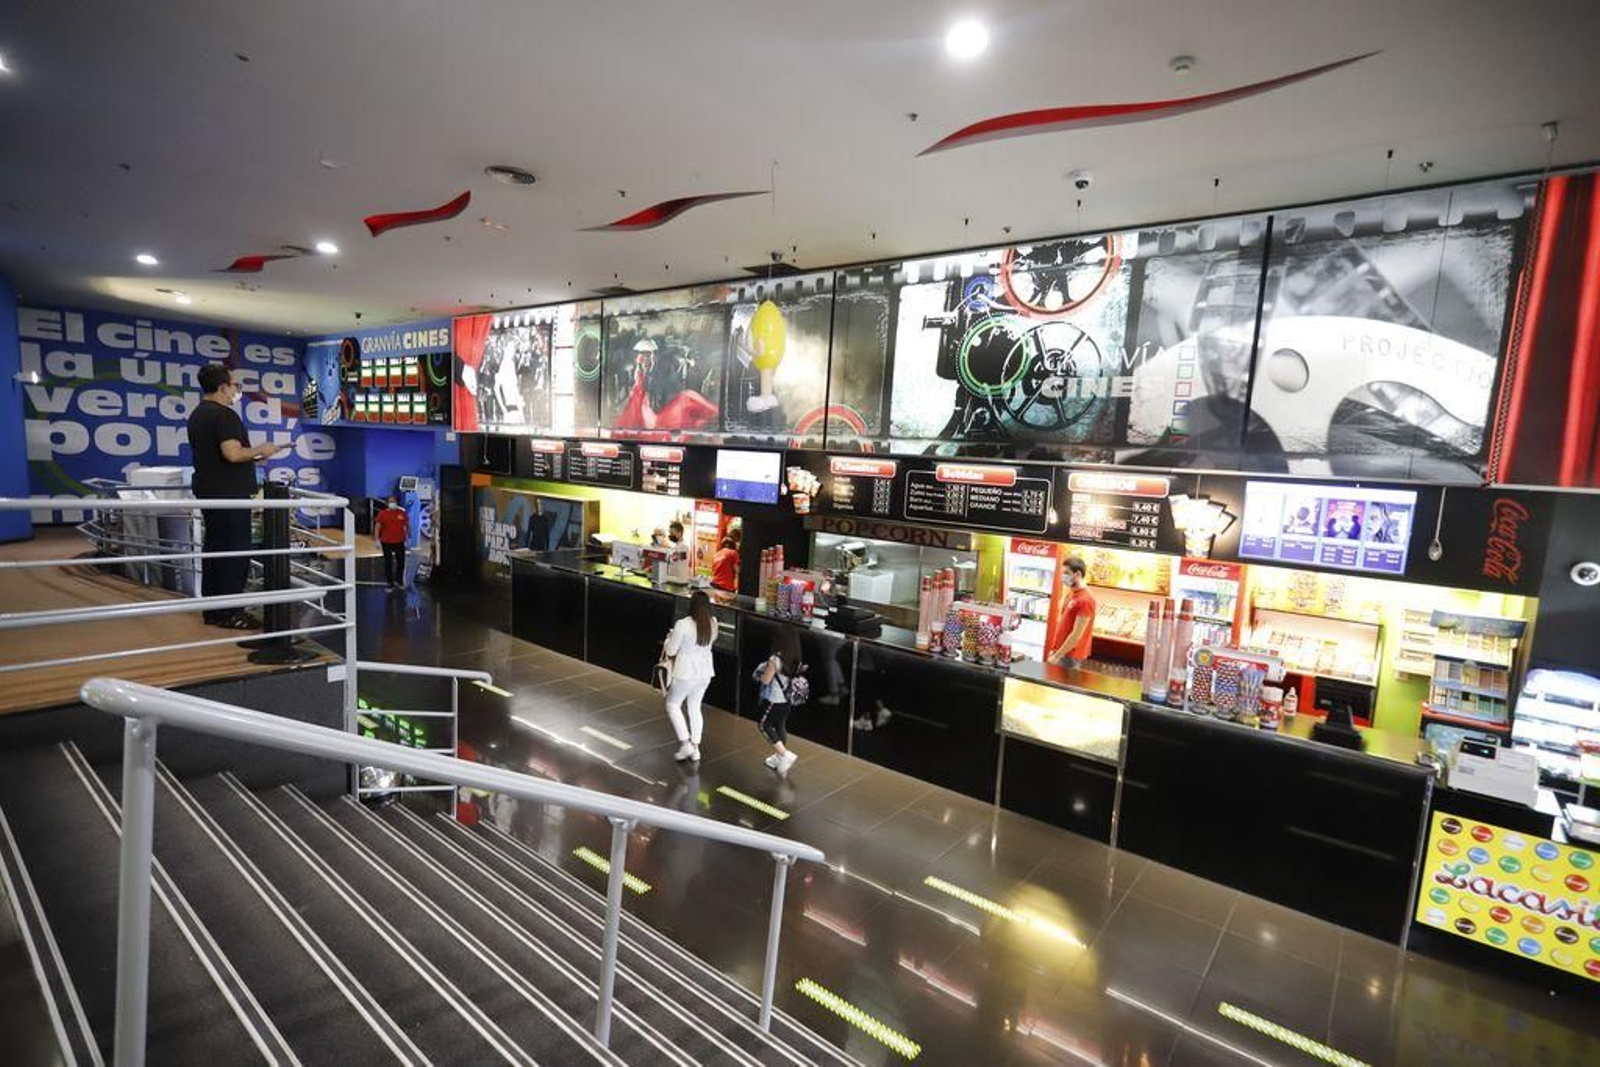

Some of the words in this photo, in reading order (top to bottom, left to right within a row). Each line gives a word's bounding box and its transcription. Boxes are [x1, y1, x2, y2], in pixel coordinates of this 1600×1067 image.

[17, 307, 85, 343] El
[97, 319, 231, 359] cine
[244, 343, 296, 366] es
[403, 328, 449, 350] CINES
[20, 342, 94, 379] la
[120, 352, 296, 395] únca
[24, 384, 298, 430] verdd,
[24, 419, 336, 466] porue
[942, 467, 984, 480] Bebidas
[970, 495, 1000, 503] MEDIANO
[971, 487, 1002, 496] PEQUEÑO
[969, 502, 996, 510] GRANDE
[1017, 541, 1050, 556] Coca-Cola
[1483, 498, 1532, 585] Coca-Cola
[1187, 562, 1231, 579] Coca-Cola
